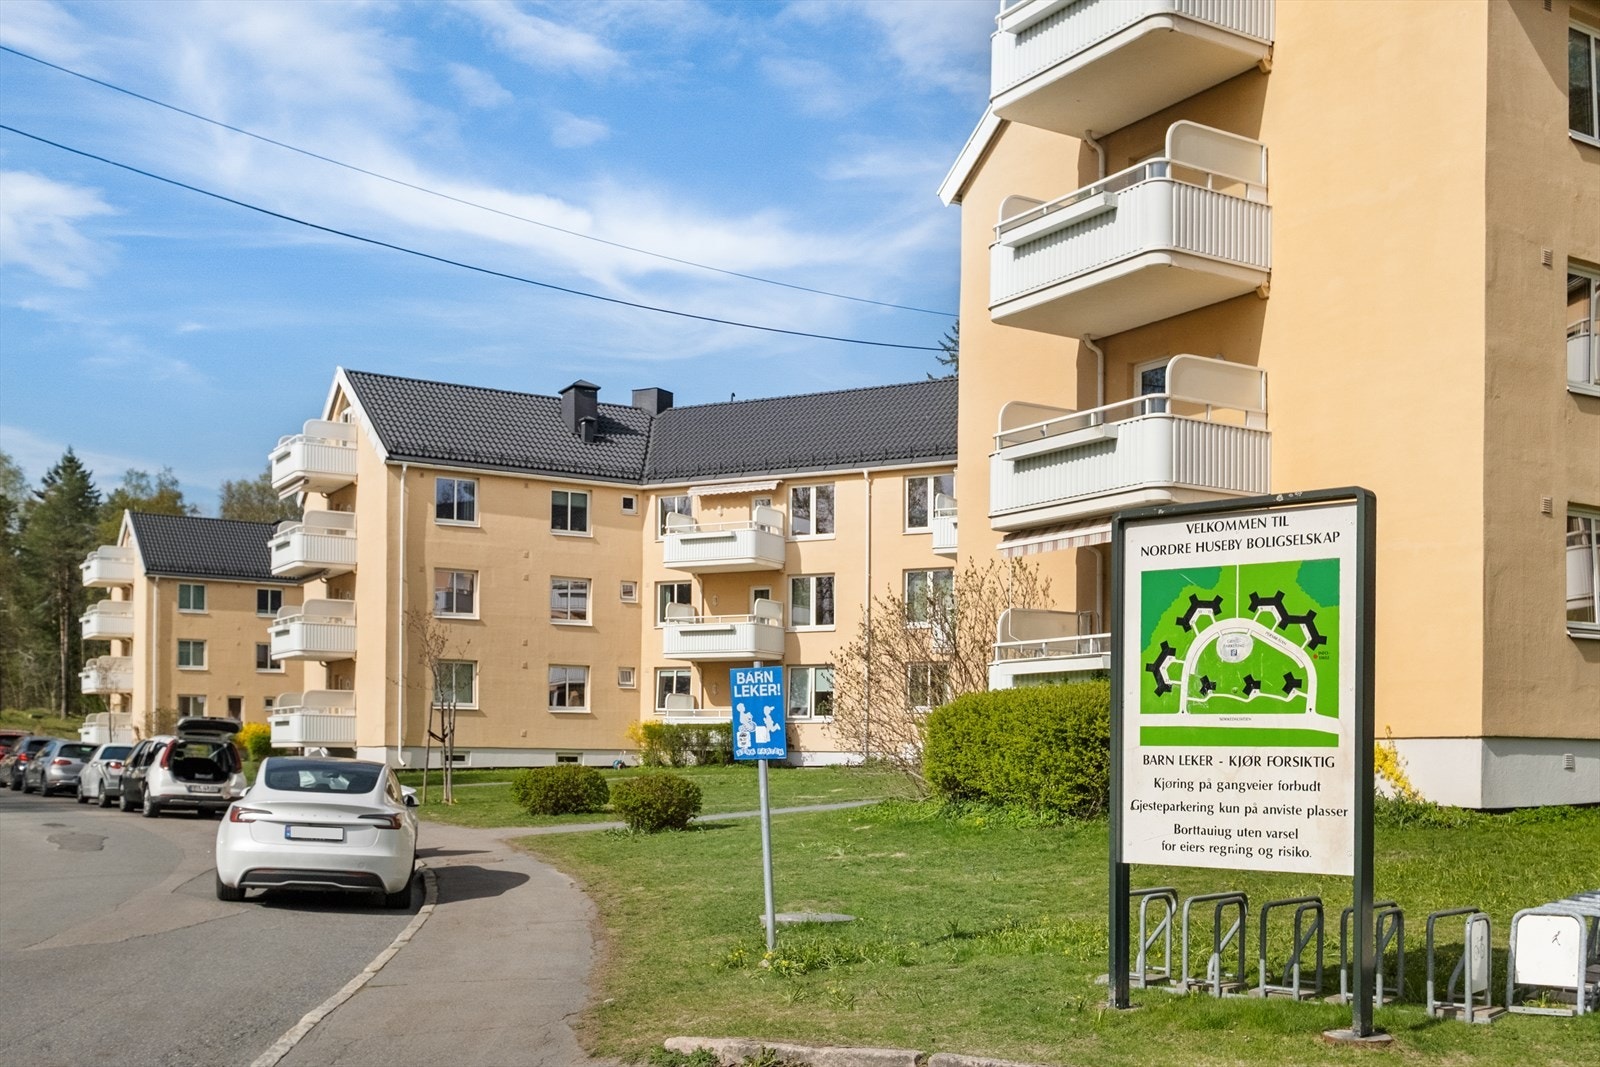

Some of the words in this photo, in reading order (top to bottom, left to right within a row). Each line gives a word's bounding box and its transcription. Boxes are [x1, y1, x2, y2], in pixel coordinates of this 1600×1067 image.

[1186, 517, 1266, 534] VELKOMMEN
[1271, 515, 1289, 528] TIL
[1140, 542, 1191, 557] NORDRE
[1195, 538, 1242, 553] HUSEBY
[1246, 531, 1341, 550] BOLIGSELSKAP
[736, 670, 773, 684] BARN
[734, 683, 780, 697] LEKER!
[1143, 754, 1175, 766] BARN
[1178, 754, 1213, 767] LEKER
[1229, 755, 1262, 768] KJØR
[1266, 755, 1336, 768] FORSIKTIG
[1154, 777, 1194, 792] Kjøring
[1199, 778, 1213, 793] på
[1216, 780, 1274, 794] gangveier
[1277, 779, 1321, 792] forbudt
[1130, 799, 1215, 816] Gjesteparkering
[1219, 801, 1240, 814] kun
[1244, 802, 1258, 817] på
[1262, 804, 1303, 816] anviste
[1307, 804, 1349, 820] plasser
[1236, 827, 1262, 838] uten
[1265, 828, 1299, 840] varsel
[1161, 840, 1176, 851] for
[1180, 841, 1205, 853] eiers
[1209, 843, 1254, 858] regning
[1257, 847, 1274, 859] og
[1278, 845, 1312, 858] risiko.
